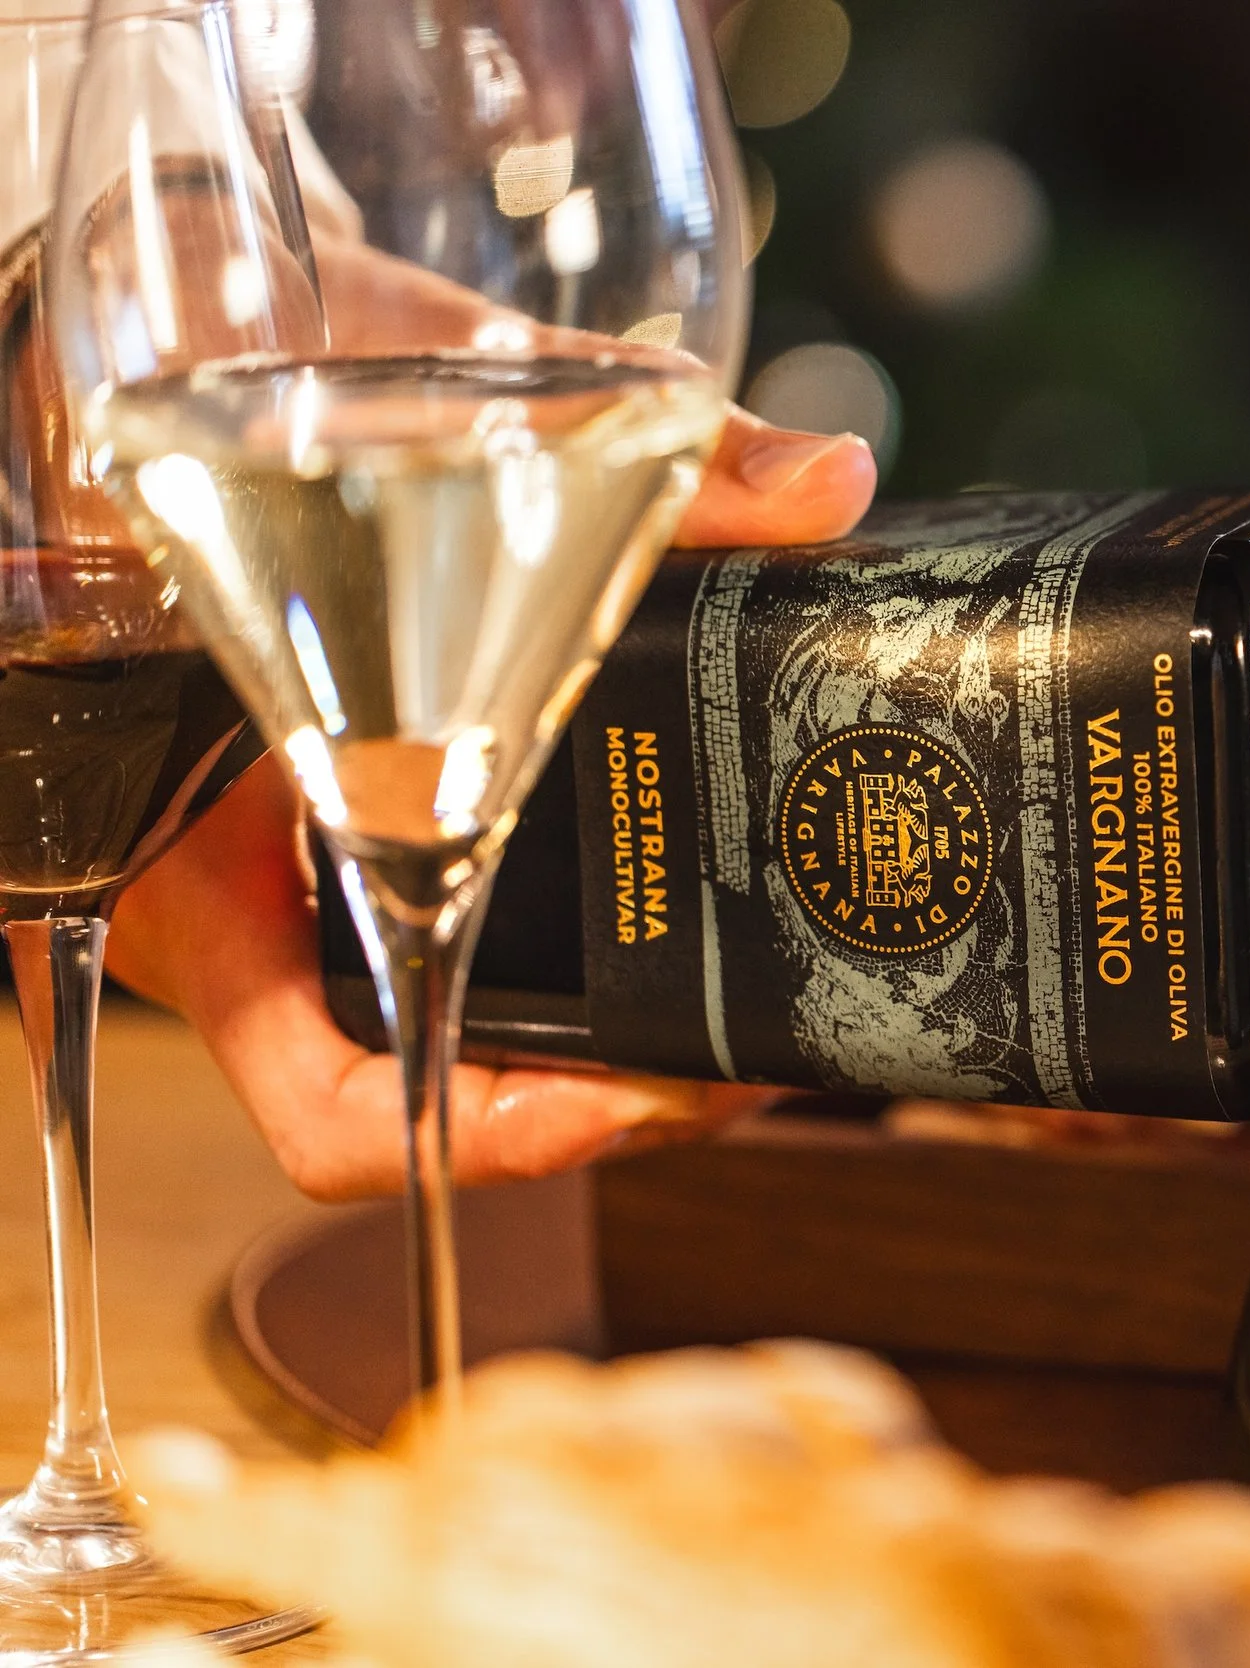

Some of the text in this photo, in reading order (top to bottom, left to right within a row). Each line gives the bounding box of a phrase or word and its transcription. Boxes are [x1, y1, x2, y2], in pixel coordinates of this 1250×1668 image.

[606, 726, 637, 945] MONOCULTIVAR
[633, 731, 669, 942] NOSTRANA
[797, 748, 877, 935] VARIGNANA
[836, 812, 846, 866] LIFESTYLE
[845, 781, 860, 898] HERITAGE OF ITALIAN
[906, 749, 979, 934] PALAZZO DI
[933, 825, 950, 859] 1705
[1086, 707, 1133, 985] VARGNANO
[1132, 751, 1159, 943] 100% ITALIANO
[1152, 652, 1189, 1041] OLIO EXTRAVERGINE DI OLIVA
